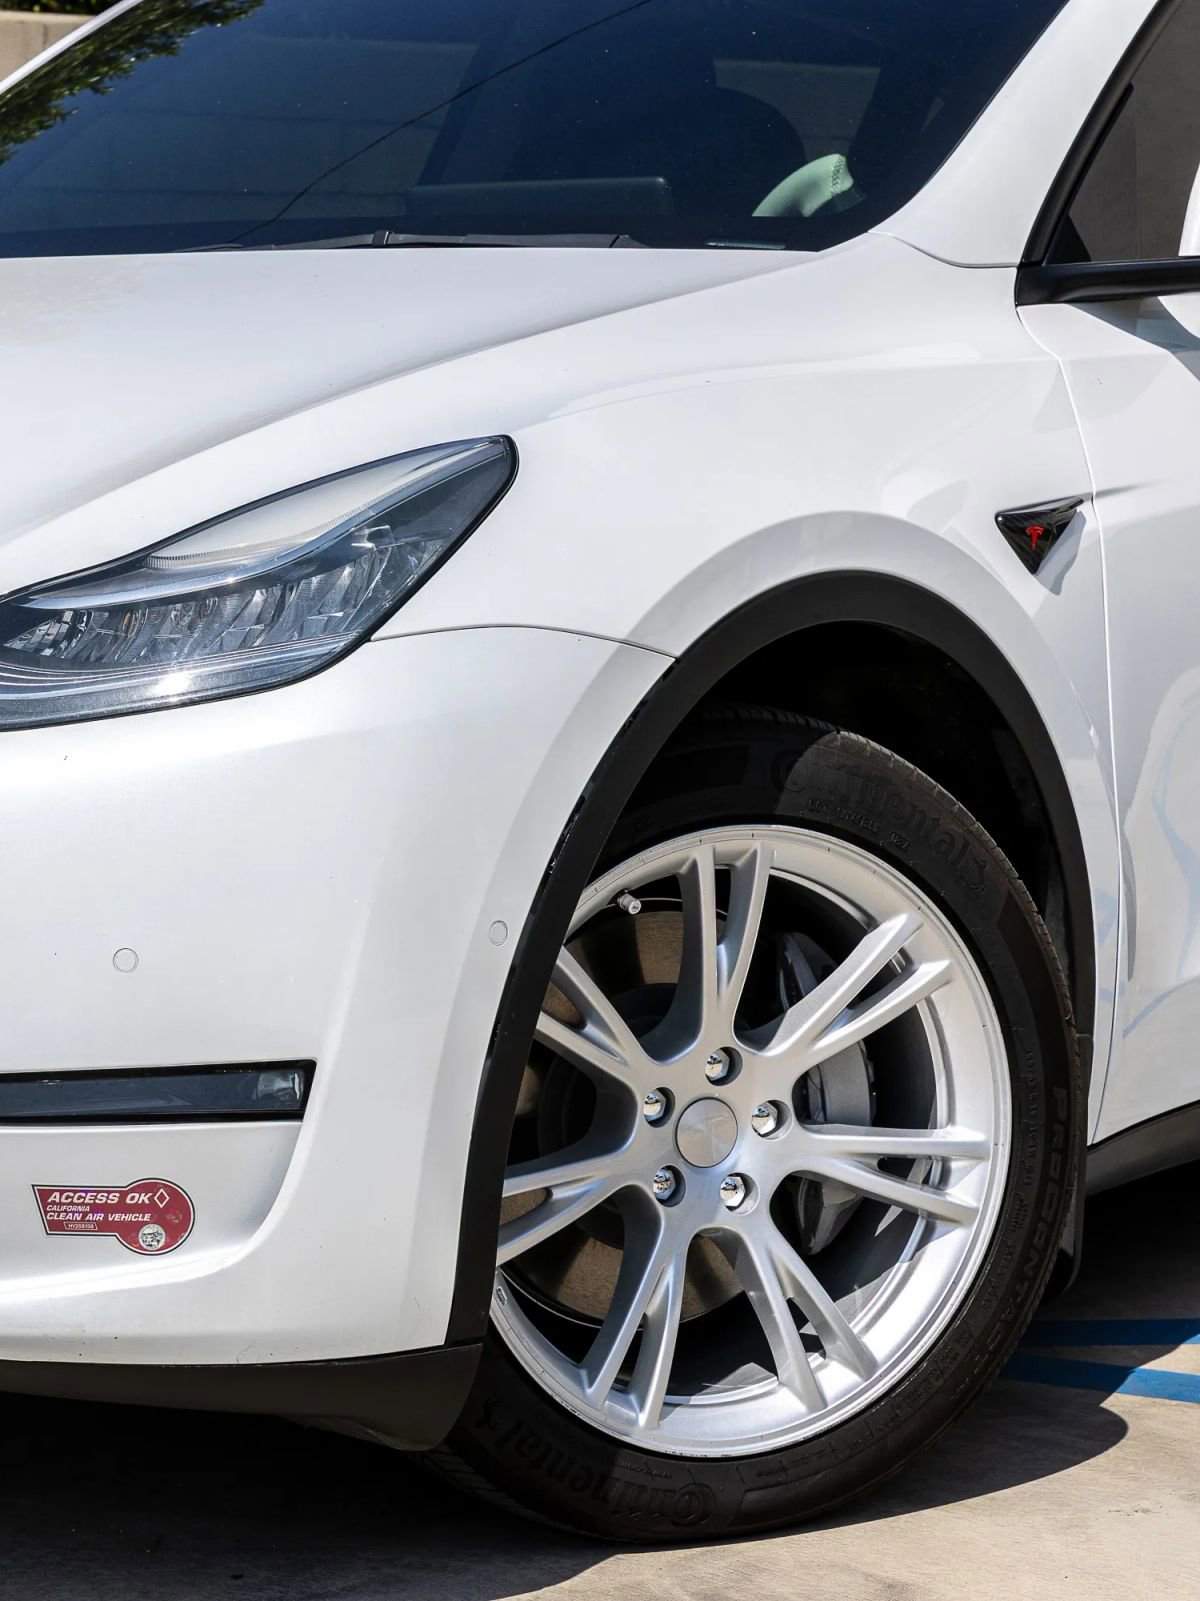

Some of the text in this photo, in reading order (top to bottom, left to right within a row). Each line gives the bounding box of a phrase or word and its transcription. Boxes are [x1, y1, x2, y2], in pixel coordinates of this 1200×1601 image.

[47, 1191, 153, 1204] ACCESS OK
[46, 1204, 90, 1212] CALIFORNIA
[46, 1212, 152, 1222] CLEAN AIR VEHICLE
